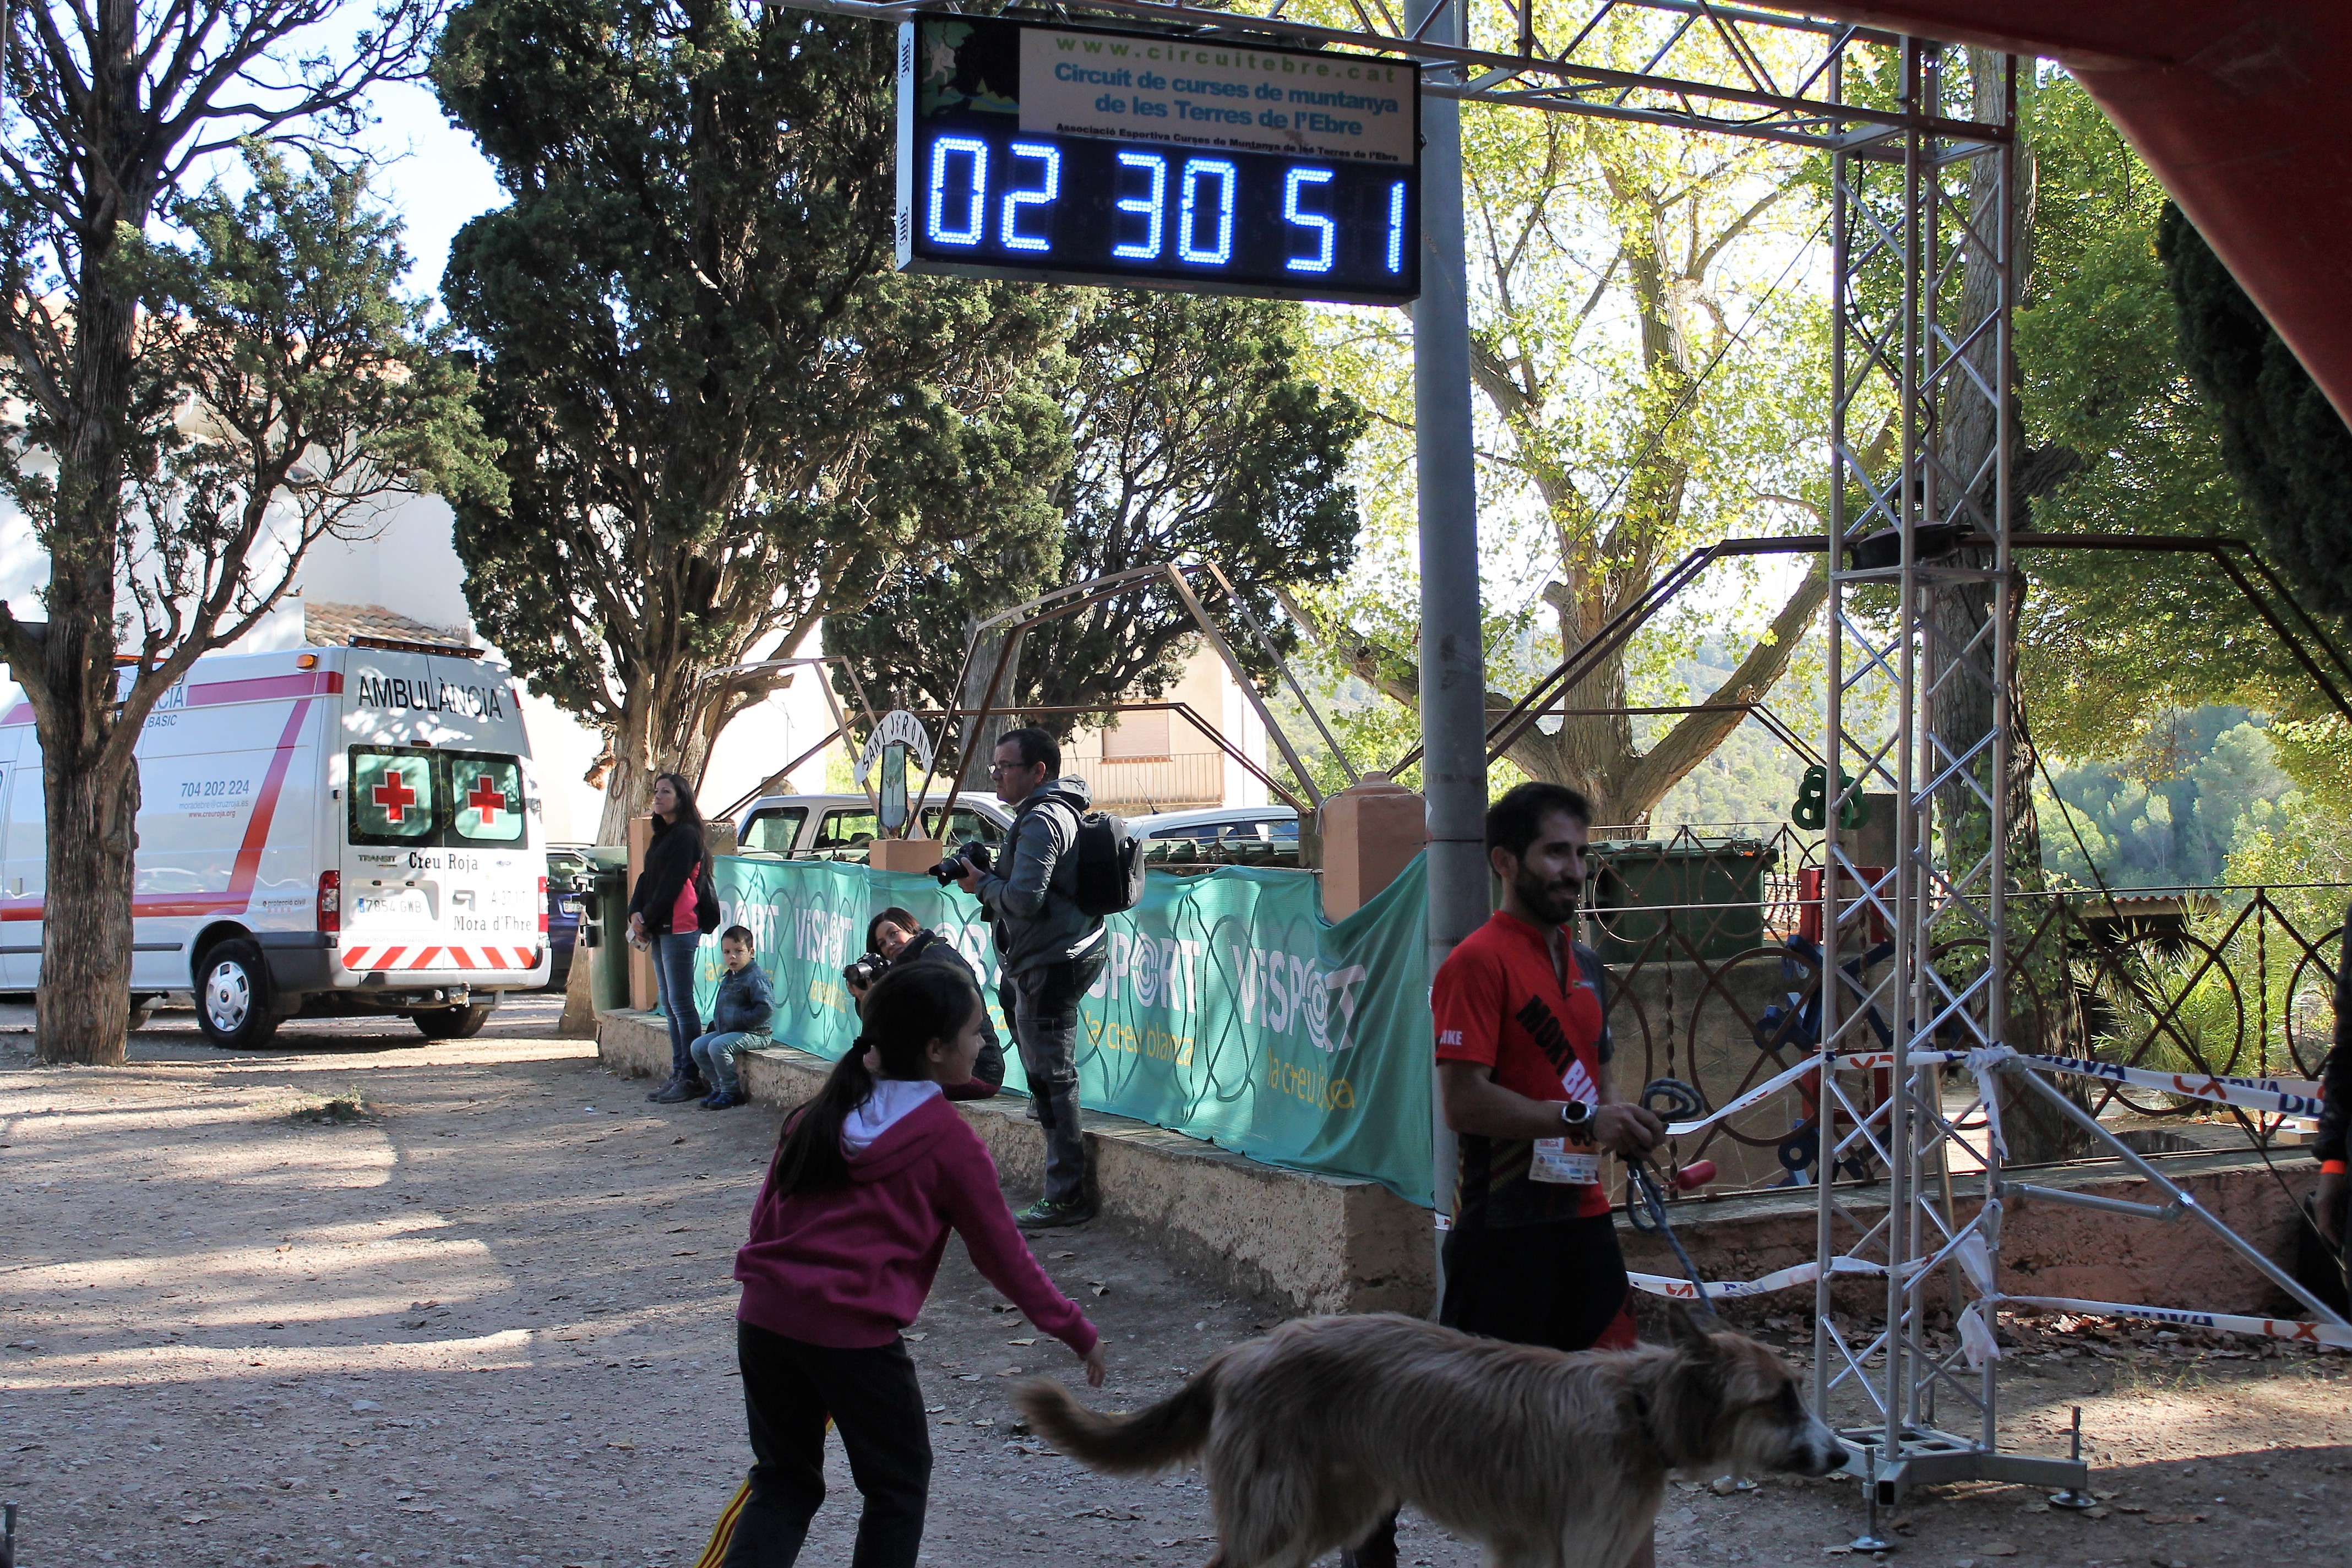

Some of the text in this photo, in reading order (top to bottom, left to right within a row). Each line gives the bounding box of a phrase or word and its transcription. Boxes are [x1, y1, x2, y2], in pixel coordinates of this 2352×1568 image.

[1055, 37, 1395, 83] www.circuitebre.cat
[1054, 62, 1399, 116] Circuit de curses de muntanya
[1095, 93, 1362, 135] de les Terres de l'Ebre
[1056, 123, 1115, 136] Associació
[1119, 128, 1170, 141] Esportiva
[1173, 133, 1211, 145] Curses
[1213, 138, 1227, 146] de
[1229, 138, 1280, 151] Muntanya
[1283, 143, 1296, 153] de
[1299, 145, 1314, 154] les
[1317, 146, 1351, 158] Terres
[1353, 150, 1366, 159] de
[926, 135, 1405, 274] 02 30 51
[358, 676, 503, 718] AMBULÀNCIA
[862, 714, 928, 771] SANT JERONI
[181, 780, 249, 797] 704 202 224
[409, 852, 478, 873] Creu Roja
[366, 899, 422, 913] 7854 GWB
[454, 915, 487, 931] Móra
[1084, 1010, 1102, 1046] la
